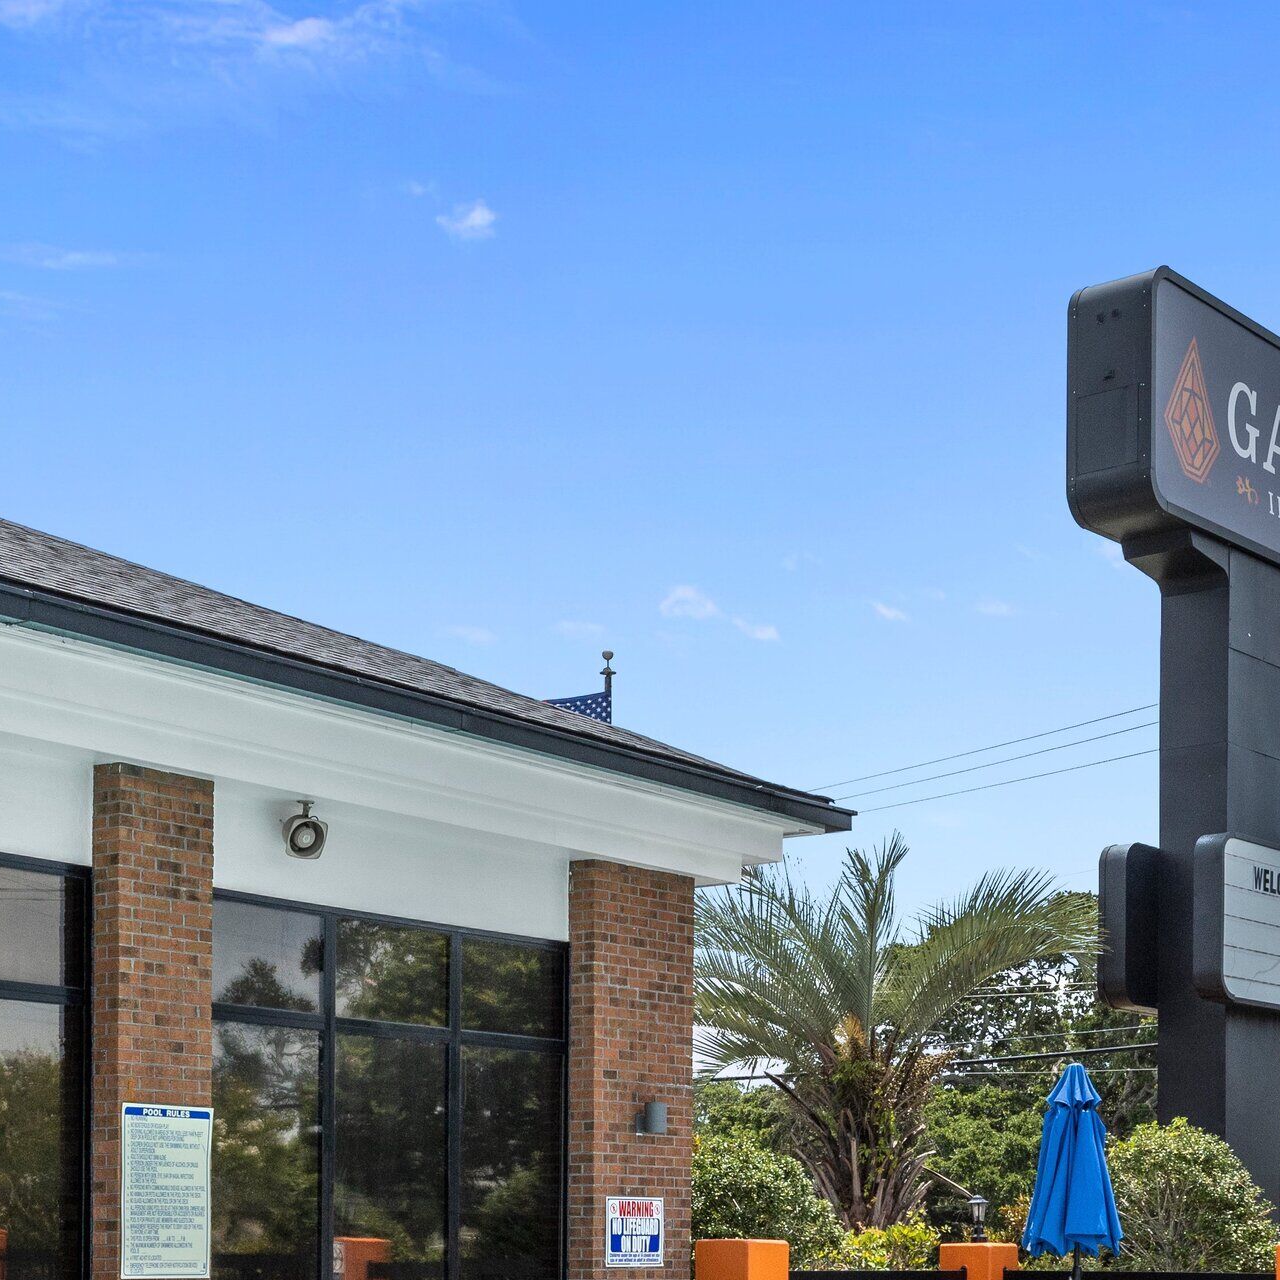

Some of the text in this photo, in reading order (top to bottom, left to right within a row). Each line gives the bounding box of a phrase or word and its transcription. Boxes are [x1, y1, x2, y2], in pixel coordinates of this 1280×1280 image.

[142, 1108, 190, 1118] POOL RULES
[619, 1201, 653, 1217] WARNING
[612, 1218, 659, 1236] NO LIFEGUARD
[621, 1235, 650, 1252] ON DUTY
